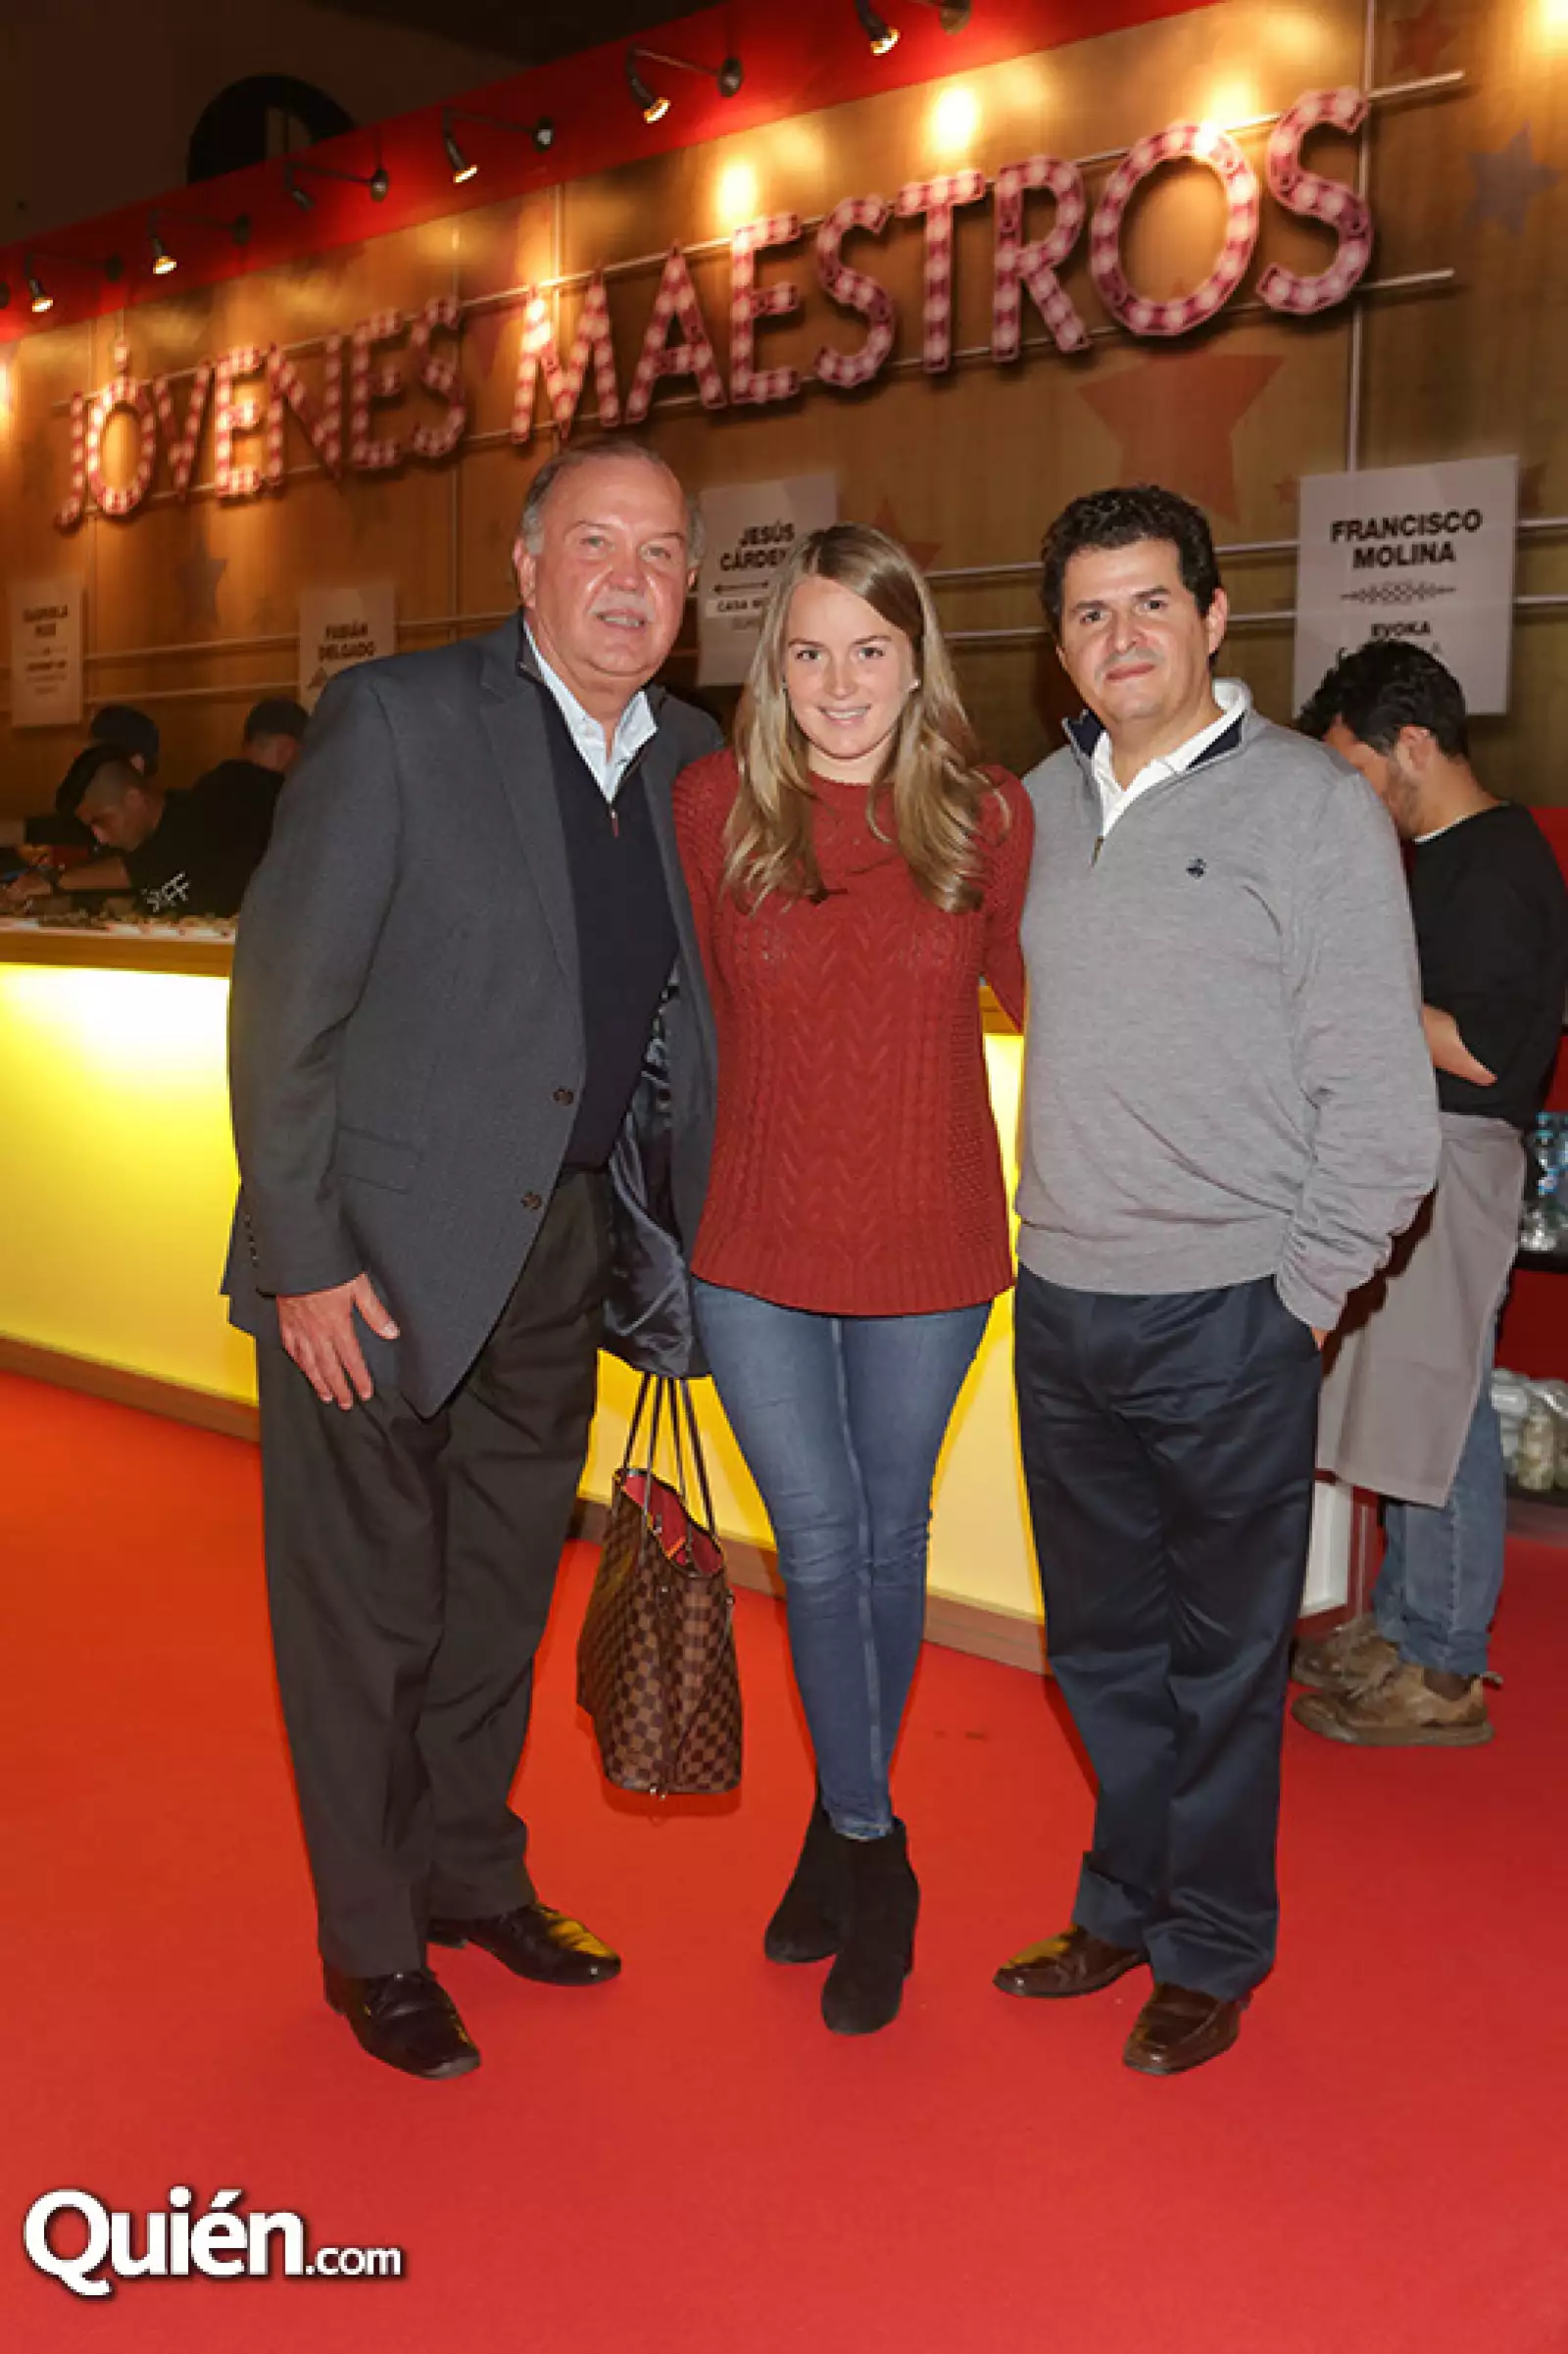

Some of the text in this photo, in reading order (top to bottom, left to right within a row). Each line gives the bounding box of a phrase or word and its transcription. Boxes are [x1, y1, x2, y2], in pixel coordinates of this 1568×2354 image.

[55, 87, 1373, 530] JÓVENES MAESTROS
[739, 519, 795, 547] JESÚS
[1330, 509, 1484, 543] FRANCISCO
[1351, 540, 1457, 569] MOLINA
